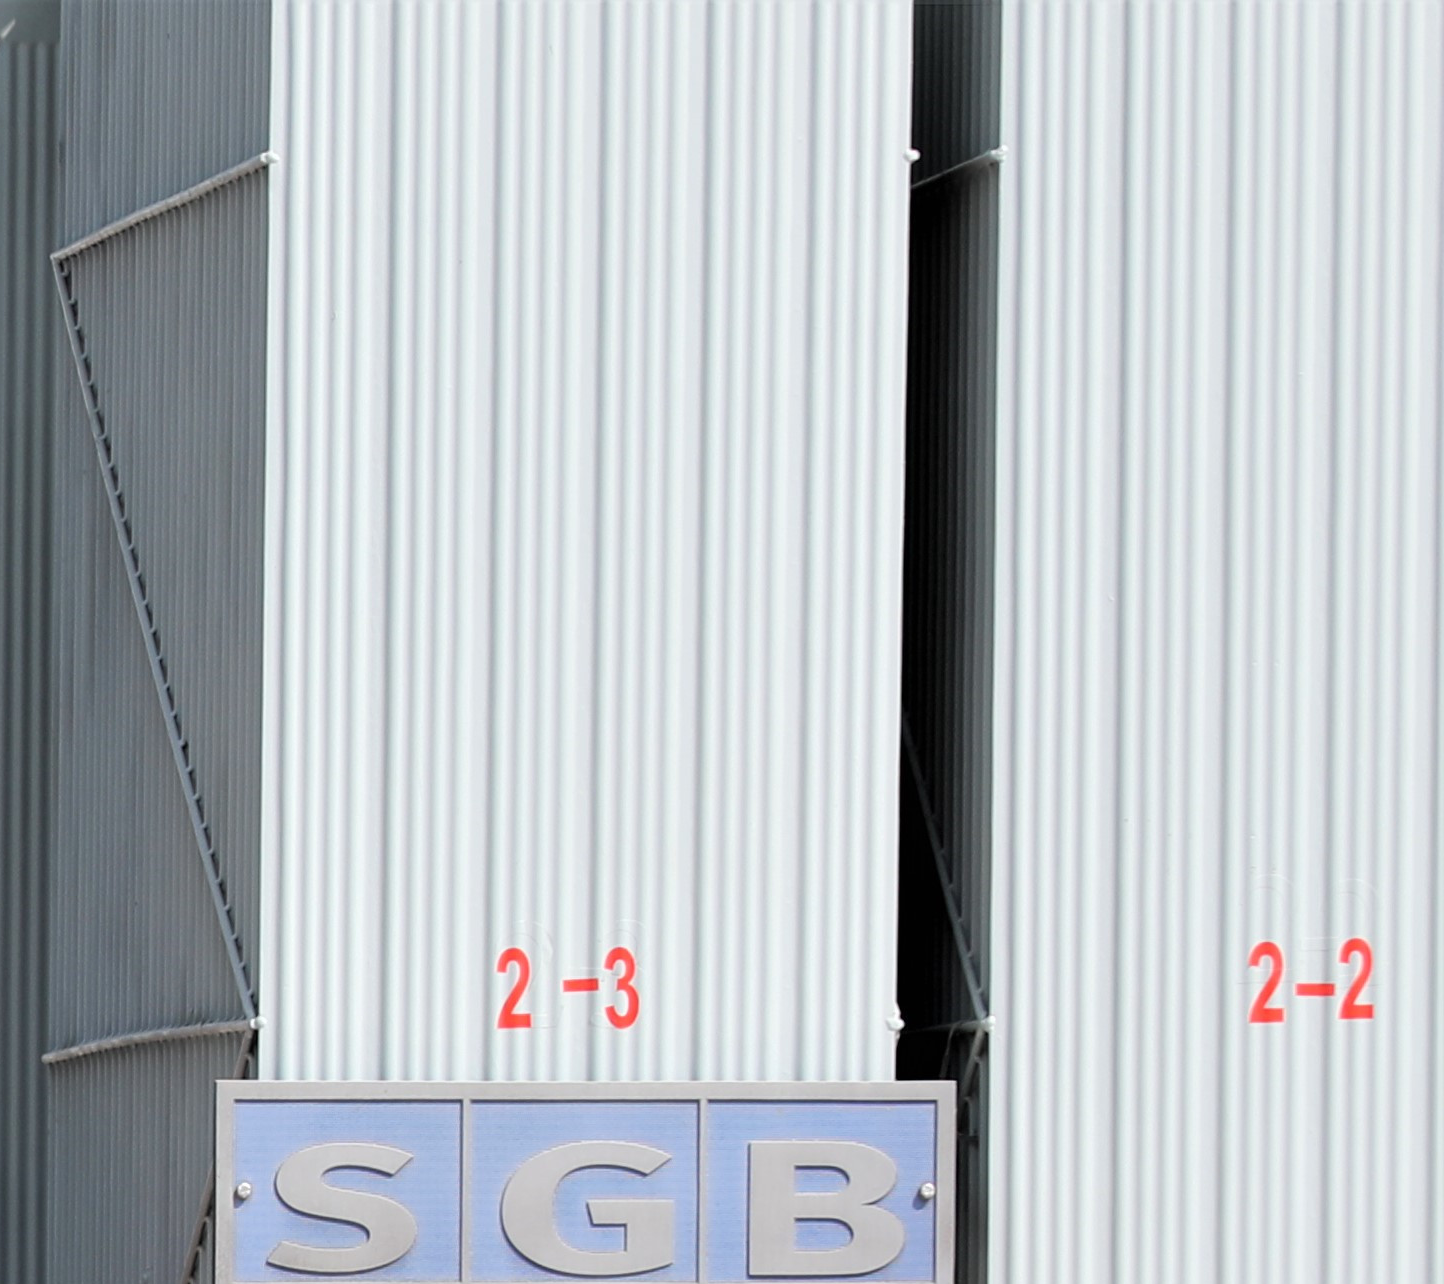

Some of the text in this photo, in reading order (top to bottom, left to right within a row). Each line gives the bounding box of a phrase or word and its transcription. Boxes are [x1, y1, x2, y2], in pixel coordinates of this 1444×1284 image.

[496, 946, 640, 1029] 2-3
[1247, 937, 1375, 1024] 2-2
[273, 1140, 905, 1277] SGB
